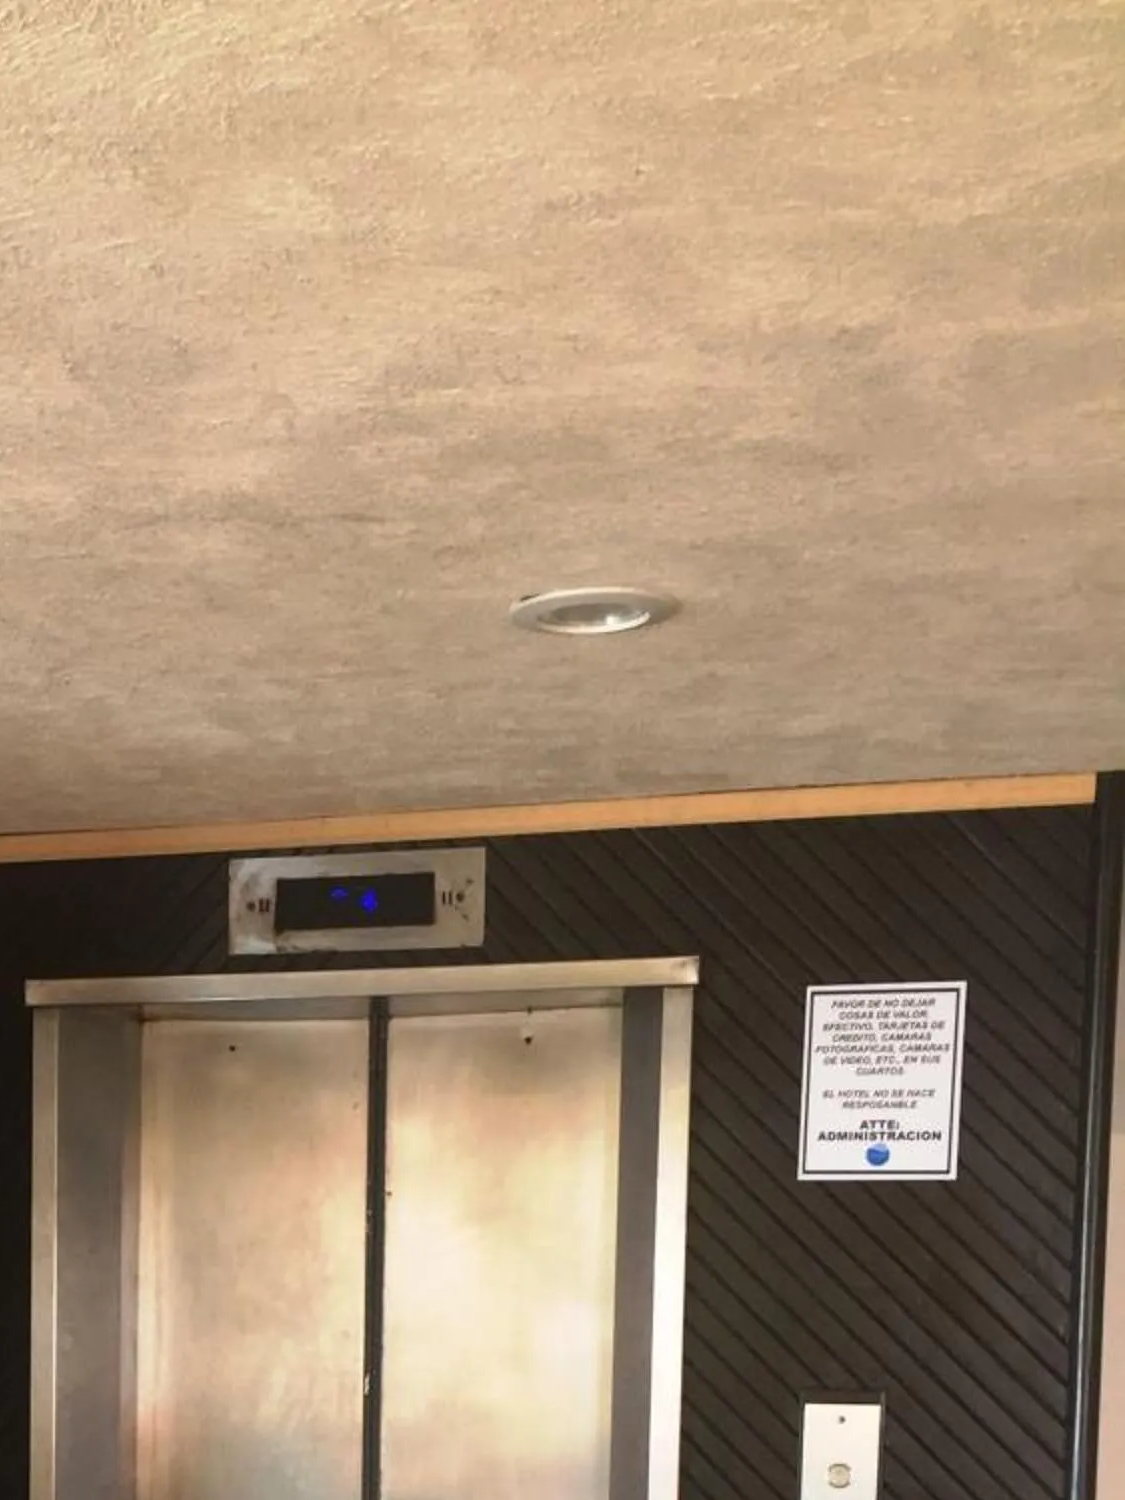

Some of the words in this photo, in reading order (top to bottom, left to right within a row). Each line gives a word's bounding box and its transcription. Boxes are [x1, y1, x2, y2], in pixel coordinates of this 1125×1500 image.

[831, 999, 865, 1008] FAVOR
[867, 999, 882, 1008] DE
[883, 999, 899, 1008] NO
[900, 998, 936, 1007] DEJAR
[838, 1011, 874, 1020] COSAS
[876, 1011, 891, 1020] DE
[878, 1022, 928, 1031] TARJETAS
[930, 1021, 946, 1030] DE
[880, 1032, 932, 1041] CAMARAS
[899, 1043, 950, 1052] CAMARAS
[823, 1056, 837, 1065] DE
[903, 1055, 920, 1064] EN
[822, 1089, 834, 1098] EL
[837, 1089, 870, 1098] HOTEL
[873, 1089, 888, 1098] NO
[891, 1089, 905, 1098] SE
[907, 1088, 935, 1097] HACE
[817, 1131, 942, 1142] ADMINISTRACION
